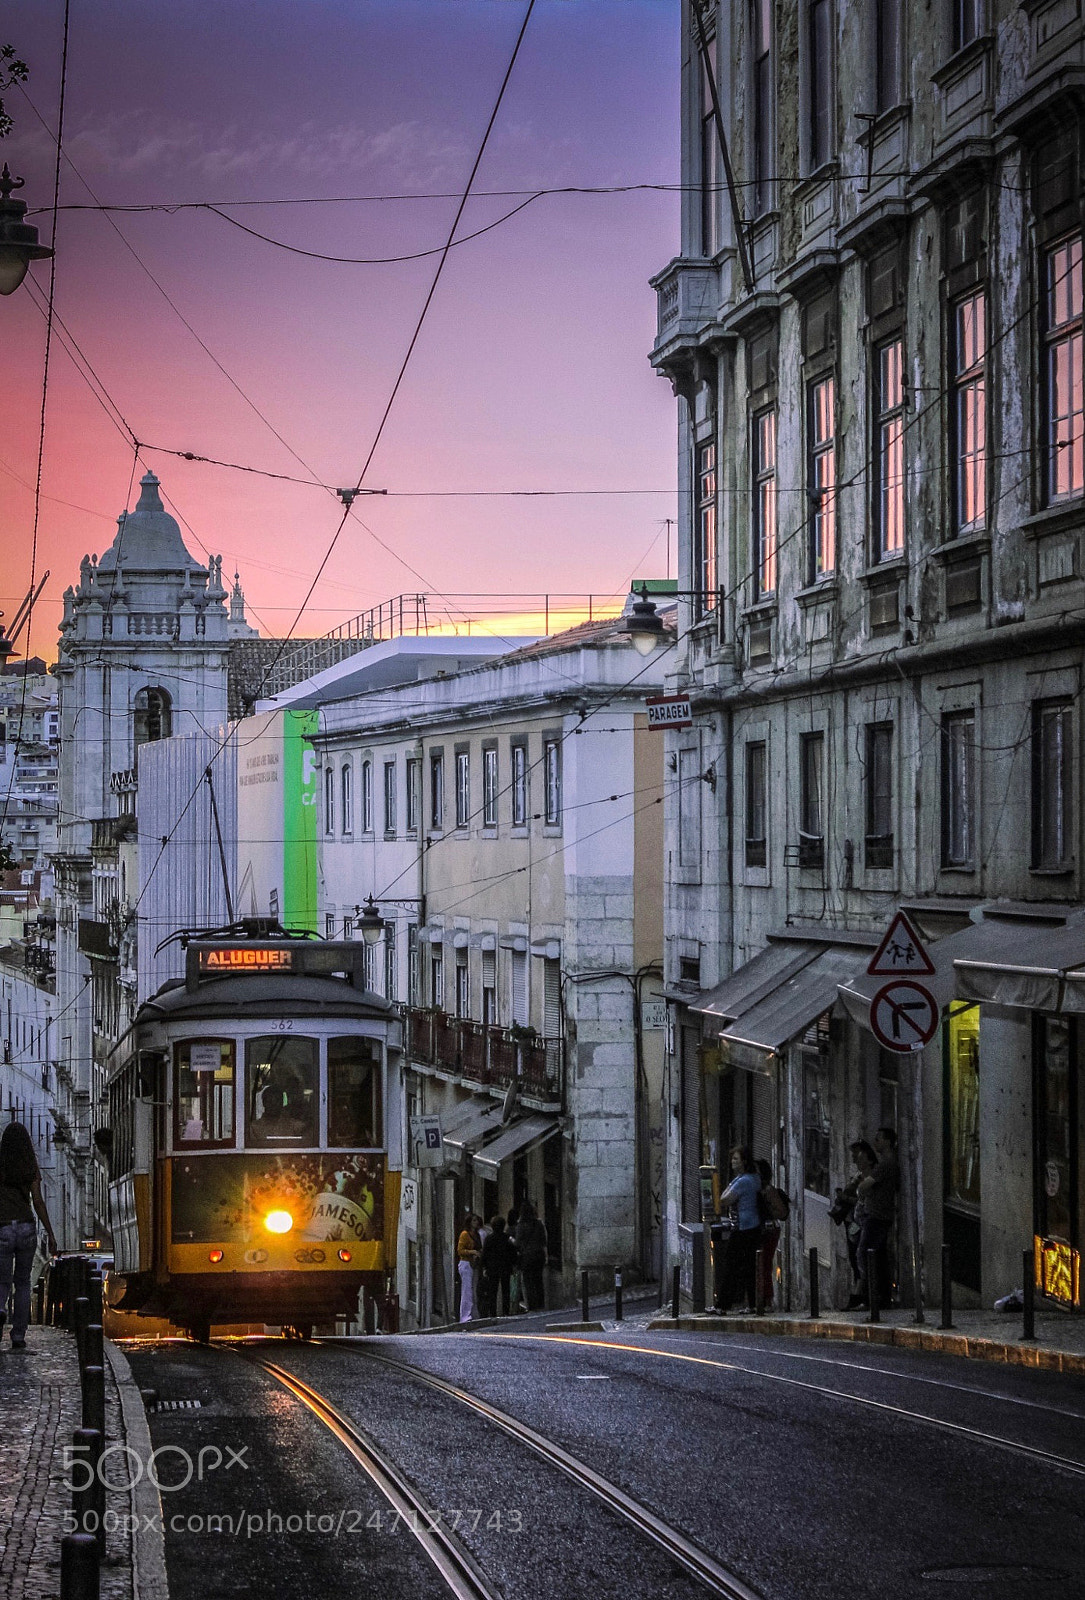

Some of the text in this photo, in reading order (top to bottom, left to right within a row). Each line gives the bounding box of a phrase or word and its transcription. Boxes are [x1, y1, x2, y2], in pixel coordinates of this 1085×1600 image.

[649, 704, 689, 721] PARAGEM
[207, 951, 291, 964] ALUGUER
[271, 1020, 293, 1030] 562
[429, 1132, 437, 1147] P
[310, 1203, 367, 1240] JAMESO
